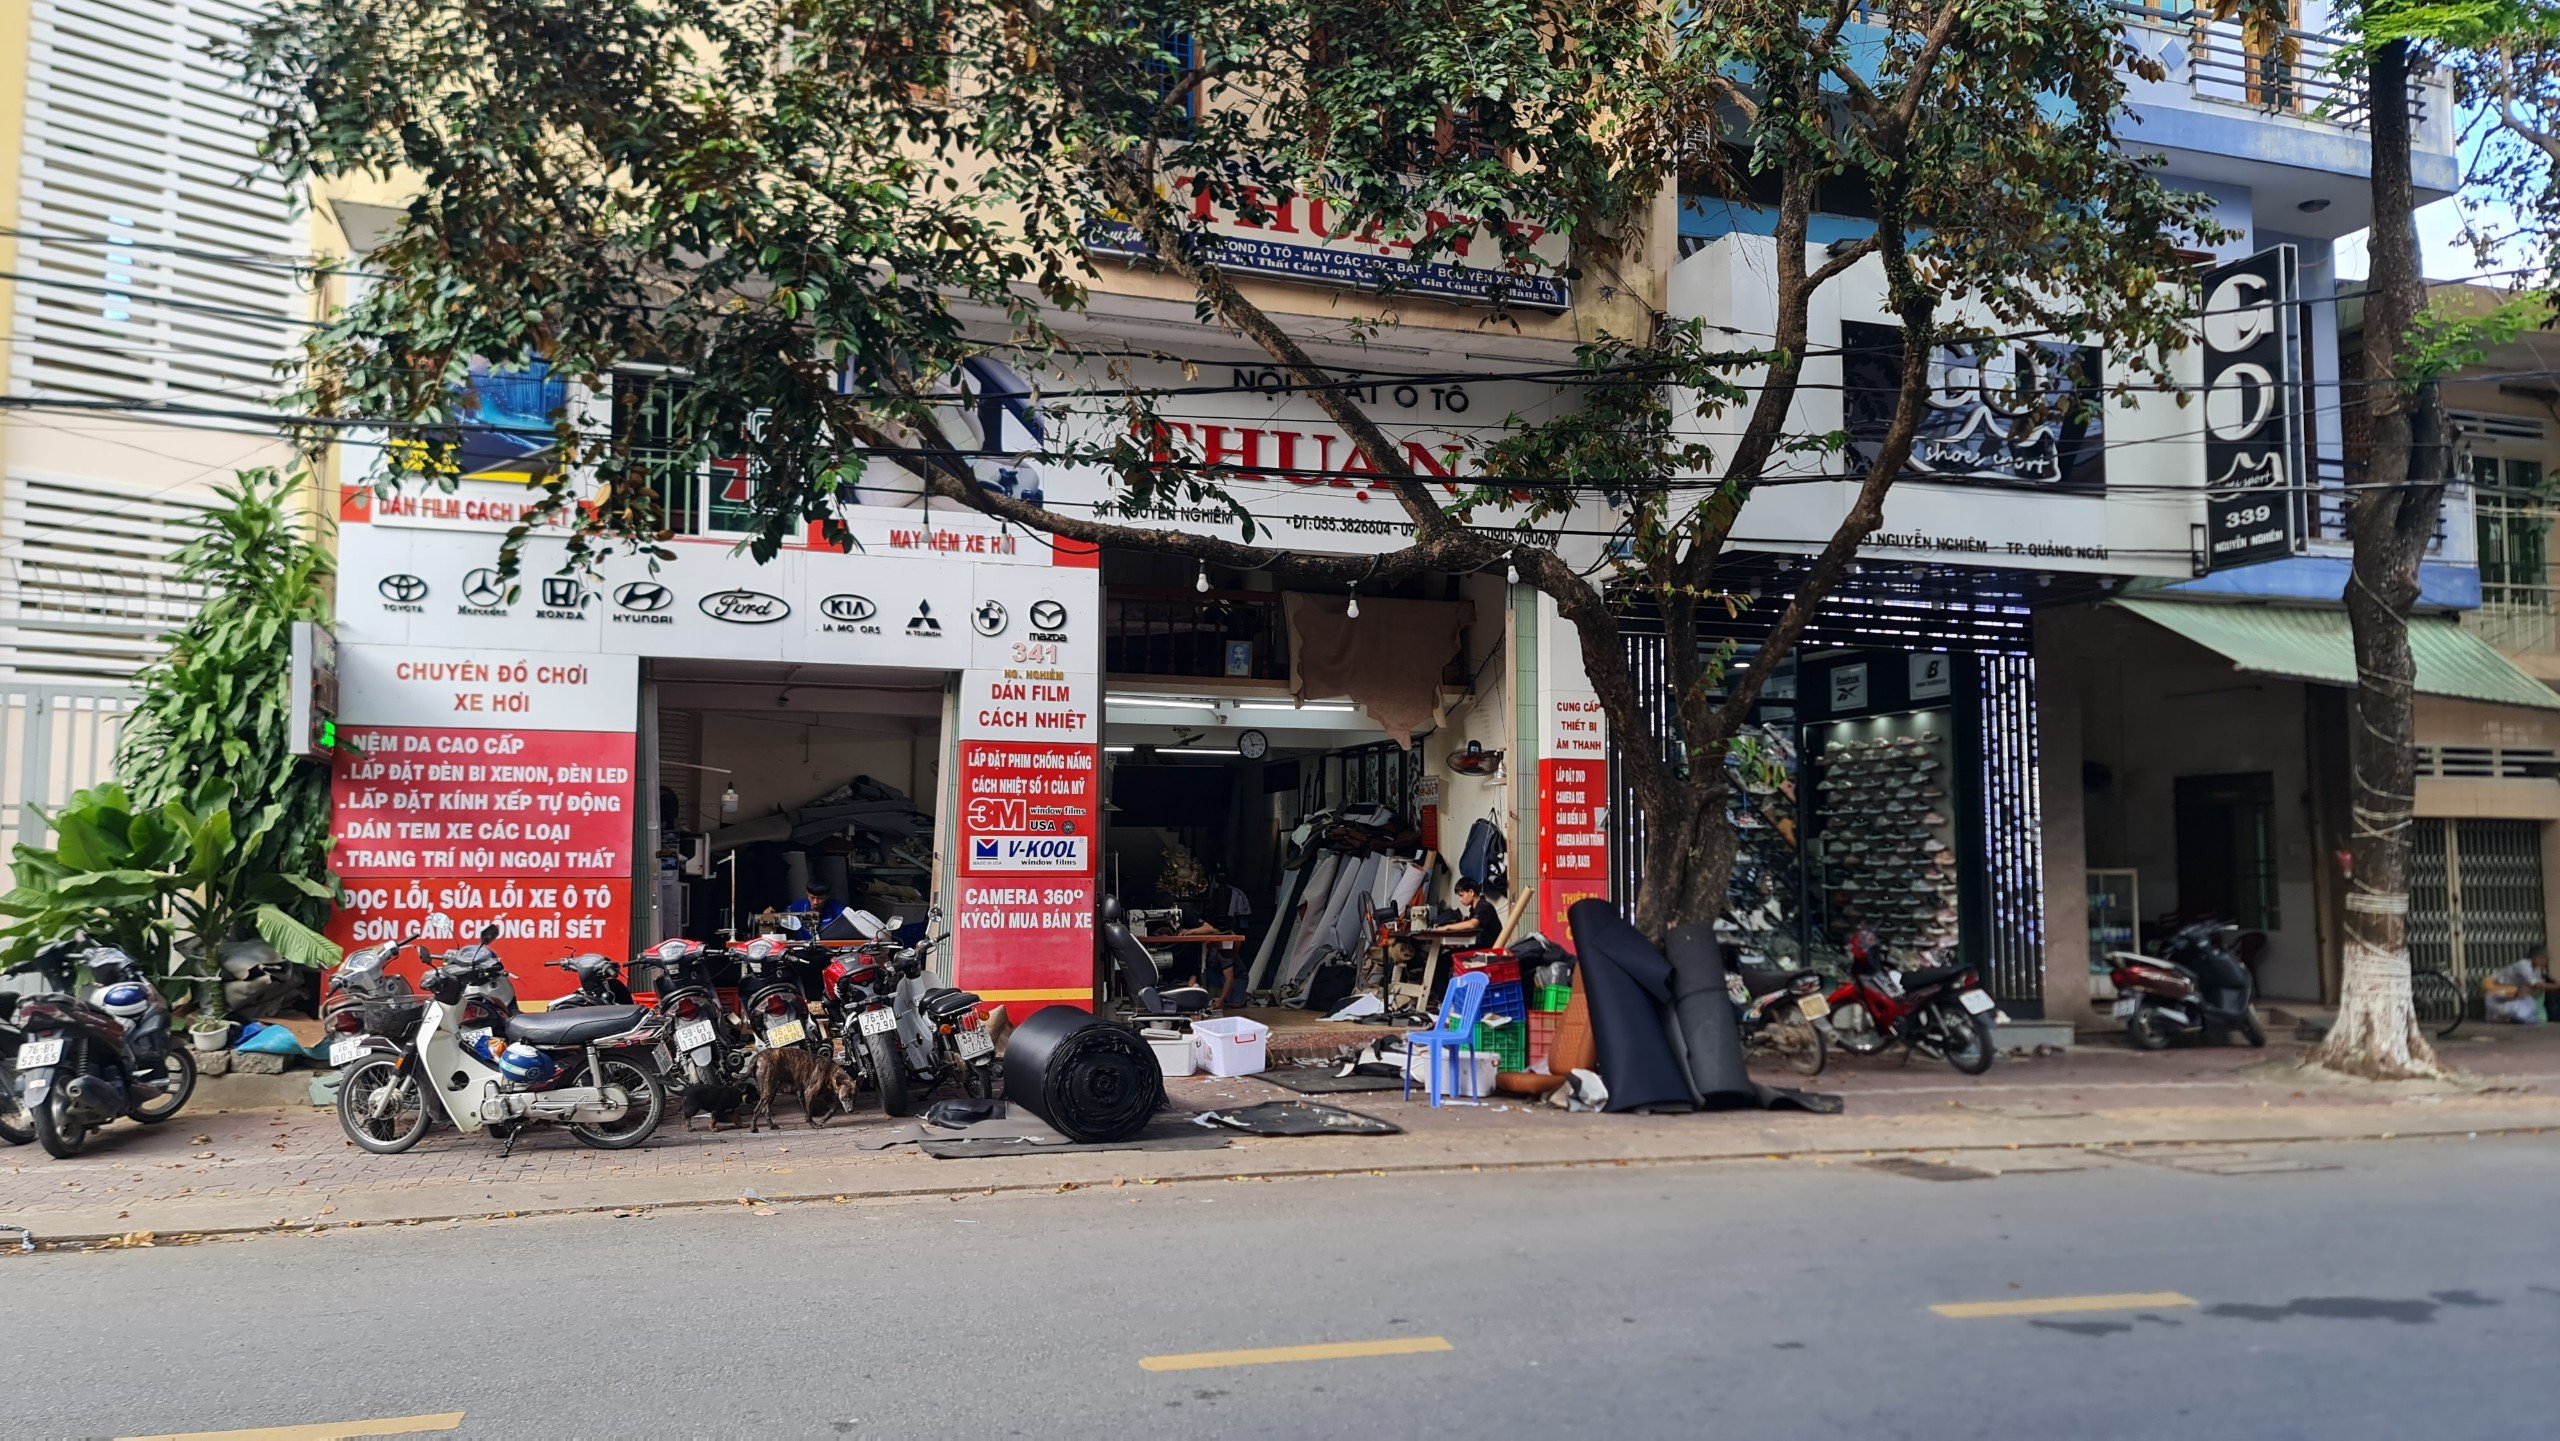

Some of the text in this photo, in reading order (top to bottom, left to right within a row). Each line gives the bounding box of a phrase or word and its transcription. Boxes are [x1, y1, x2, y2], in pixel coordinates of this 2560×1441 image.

[1294, 261, 1318, 274] Các
[1303, 250, 1331, 266] MAY
[1335, 252, 1361, 267] CÁC
[1468, 271, 1492, 284] YÊN
[1430, 384, 1470, 413] TÔ
[1925, 442, 1986, 468] shoes
[379, 494, 511, 521] DÁN FILM CÁCH
[1181, 505, 1234, 525] NGHIÊM
[2225, 505, 2271, 528] 339
[890, 529, 921, 549] MAY
[928, 528, 960, 556] NỆM
[965, 534, 985, 553] XE
[1877, 529, 1931, 549] NGUYỄN
[1936, 536, 1988, 553] NGHIÊM
[2028, 539, 2073, 558] QUẢNG
[383, 603, 423, 613] TOYOTA
[457, 604, 509, 616] Mercedes
[536, 610, 586, 620] HONDA
[714, 594, 773, 616] Ford
[830, 599, 866, 616] KIA
[613, 614, 673, 624] HYUNDAI
[1012, 642, 1058, 665] 341
[396, 659, 588, 685] CHUYÊN ĐỒ CHƠI
[991, 680, 1070, 702] DÁN FILM
[454, 693, 530, 713] XE HƠI
[1556, 699, 1599, 712] CUNG CẤP
[979, 706, 1087, 733] CÁCH NHIỆT
[1561, 718, 1585, 731] THIẾT
[352, 731, 398, 755] NỆM
[404, 736, 431, 752] DA
[437, 737, 479, 754] CAO
[484, 733, 524, 755] CẤP
[1573, 740, 1601, 751] THANH
[1008, 754, 1031, 769] PHIM
[1033, 750, 1064, 770] CHỐNG
[389, 761, 628, 786] ĐẶT ĐÈN BI XENON, ĐÈN LED
[972, 775, 997, 794] CÁCH
[1000, 775, 1027, 796] NHIỆT
[393, 789, 621, 816] ĐẶT KÍNH XẾP TỰ ĐỘNG
[1030, 806, 1086, 816] window films
[968, 797, 1026, 831] 3M
[398, 818, 571, 845] TEM XE CÁC LOẠI
[1030, 820, 1056, 832] USA
[422, 847, 615, 872] TRÍ NỘI NGOẠI THẤT
[1008, 840, 1077, 858] V-KOOL
[1055, 858, 1077, 866] films
[344, 889, 387, 914] ĐỌC
[440, 881, 483, 909] SỬA
[489, 880, 523, 909] LỖI
[528, 889, 557, 908] XE
[563, 884, 578, 909] Ô
[583, 884, 612, 908] TÔ
[966, 889, 1039, 905] CAMERA
[353, 915, 399, 941] SƠN
[539, 912, 560, 938] RỈ
[565, 913, 606, 938] SÉT
[1009, 913, 1038, 928] MUA
[1043, 909, 1071, 929] BÁN
[1075, 913, 1092, 929] XE
